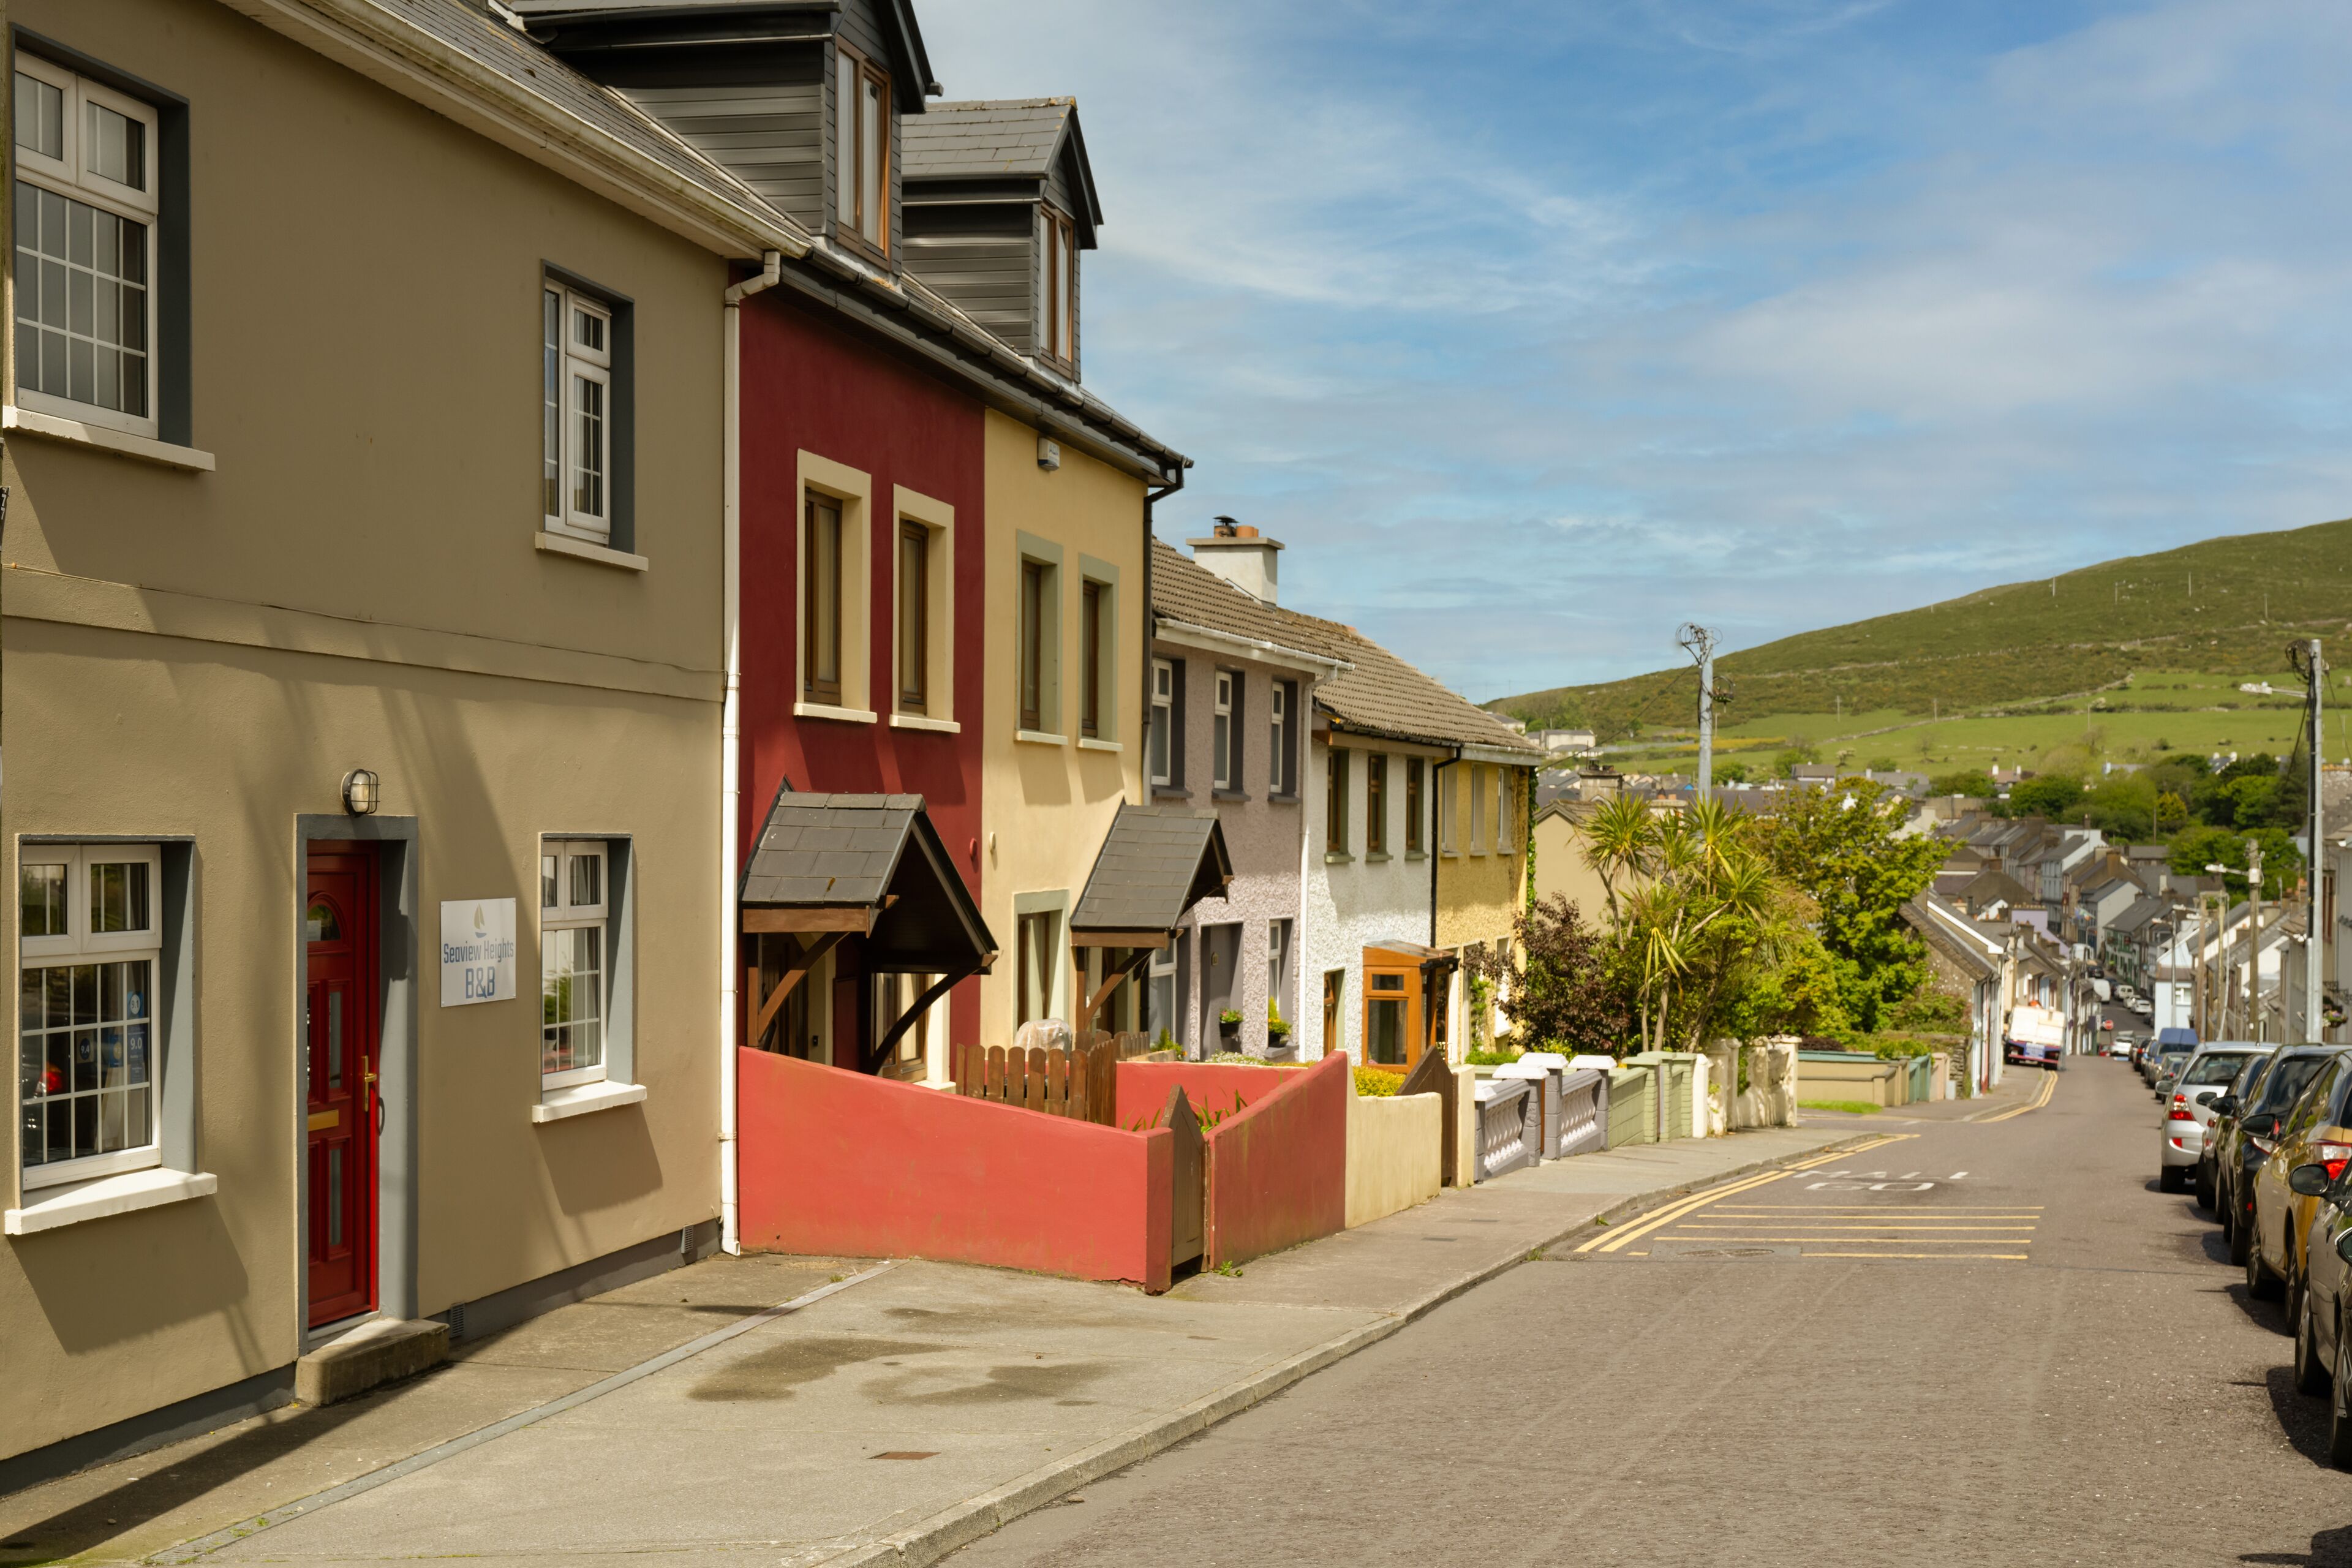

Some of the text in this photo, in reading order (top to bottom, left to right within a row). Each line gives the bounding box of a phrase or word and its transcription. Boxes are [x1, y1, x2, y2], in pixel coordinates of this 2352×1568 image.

[444, 938, 513, 963] Seaview Heights
[466, 967, 495, 998] B&B
[130, 1038, 142, 1050] 9.0
[1793, 1170, 1990, 1179] MALL
[1804, 1182, 1934, 1191] GO
